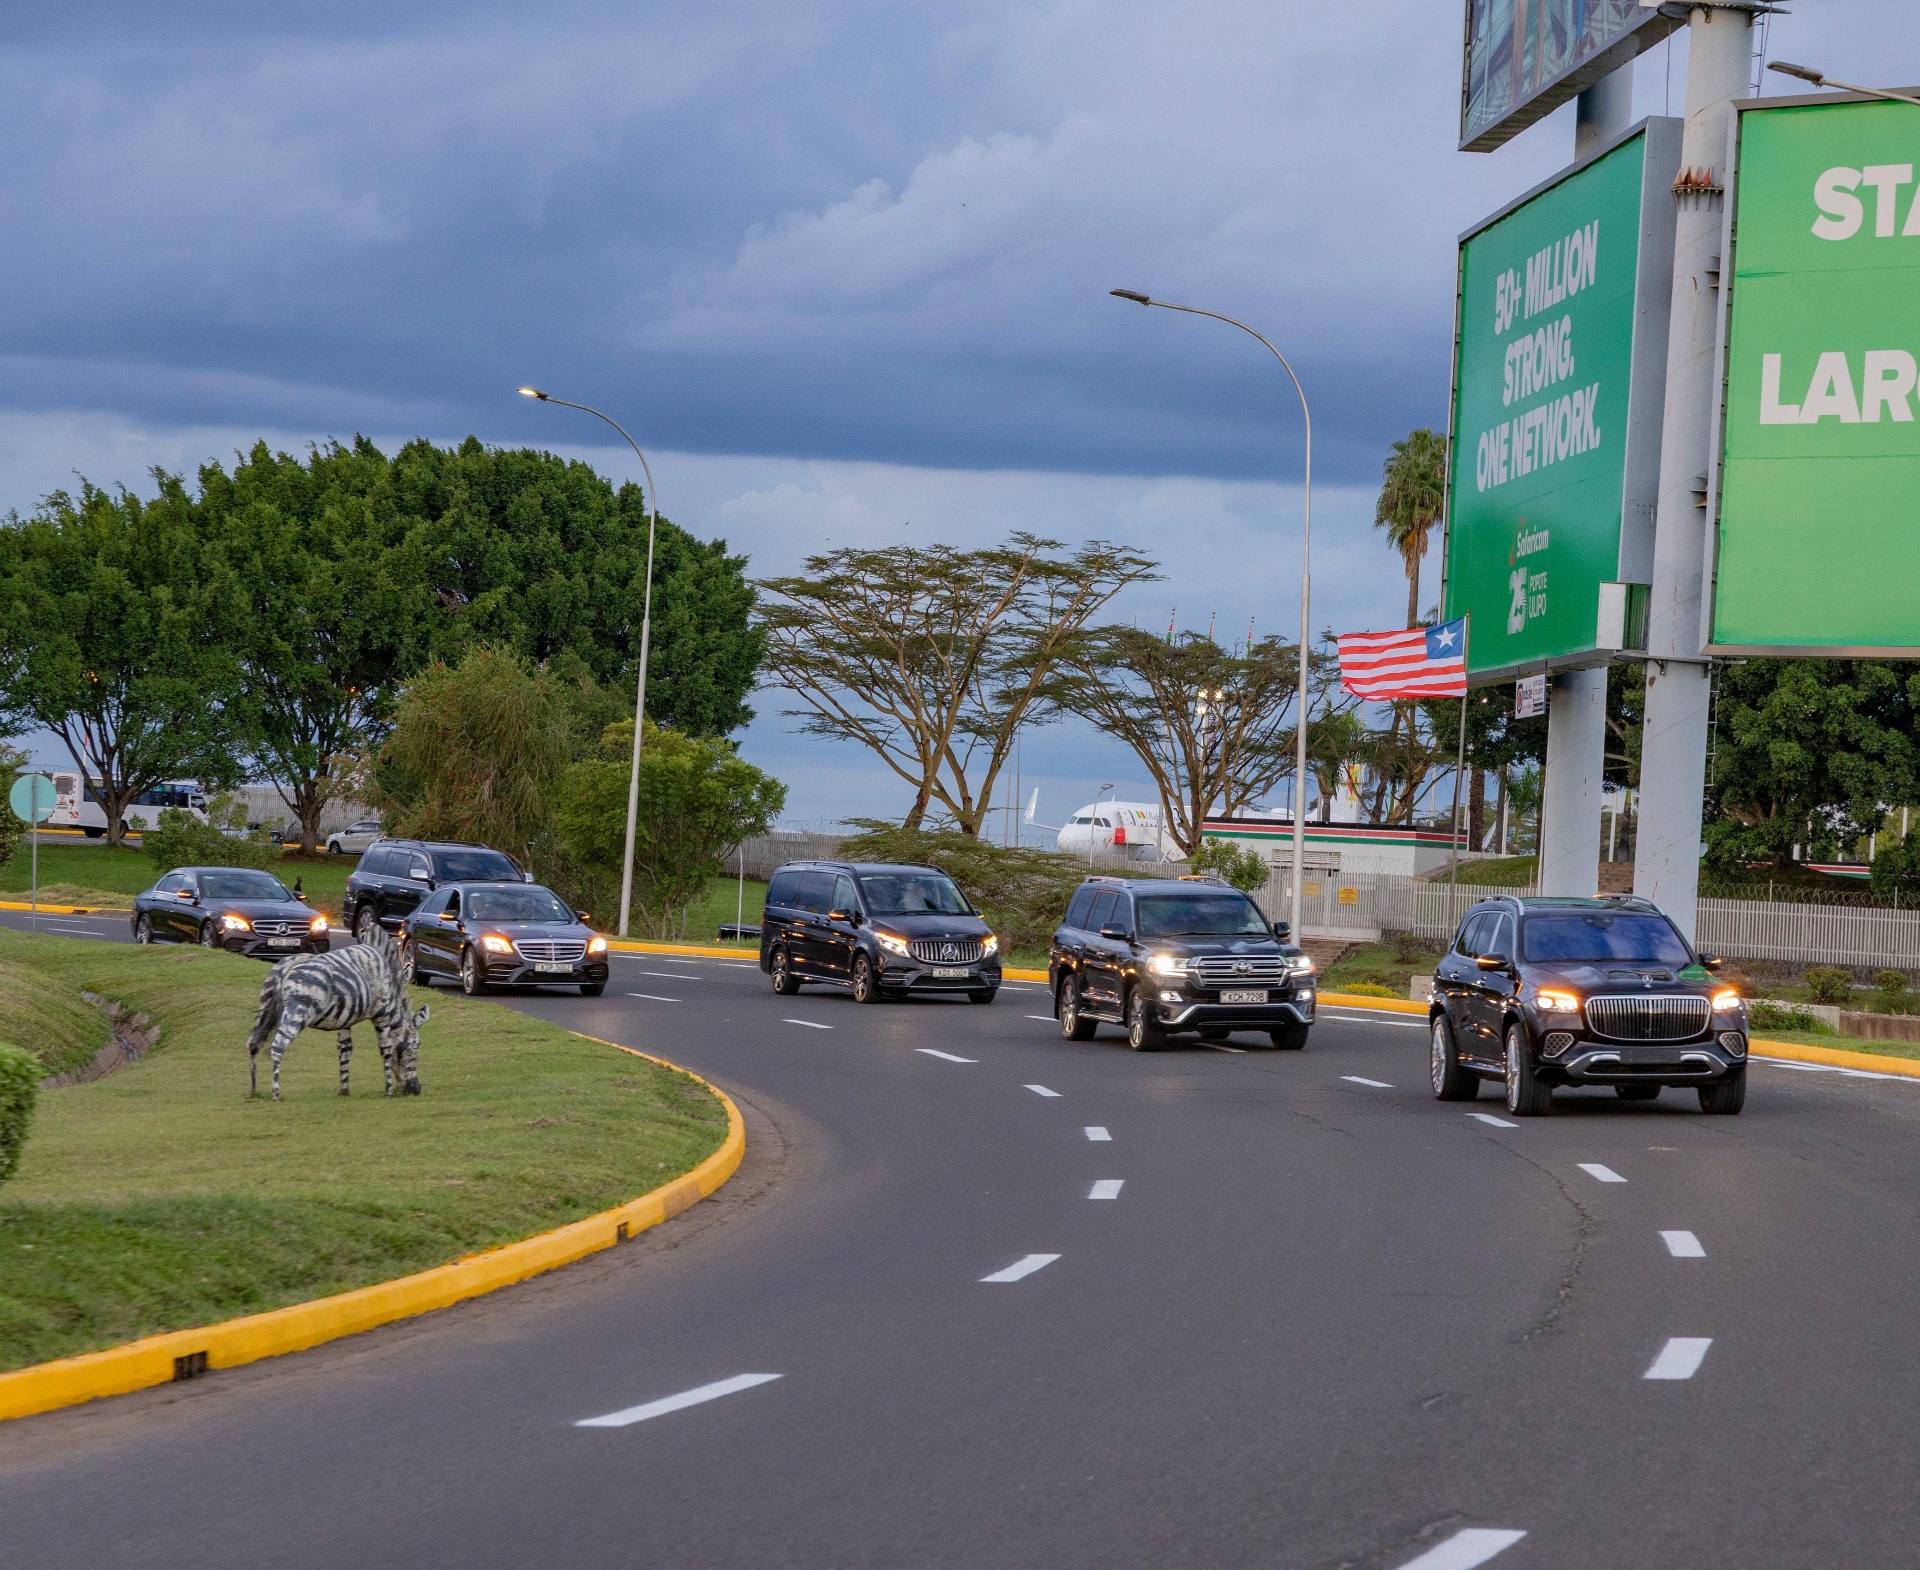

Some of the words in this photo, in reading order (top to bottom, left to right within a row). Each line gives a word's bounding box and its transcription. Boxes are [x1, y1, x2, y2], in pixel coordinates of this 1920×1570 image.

[1495, 268, 1522, 336] 50+
[1524, 219, 1599, 320] MILLION
[1503, 314, 1574, 407] STRONG.
[1760, 350, 1920, 425] LAR
[1476, 421, 1510, 493] ONE
[1510, 382, 1600, 480] NETWORK.
[1516, 525, 1549, 558] Safaricom
[1528, 592, 1547, 619] ULIPO
[1529, 571, 1548, 593] POPOTE
[1229, 993, 1243, 1001] KCH
[1246, 992, 1264, 1001] 729B
